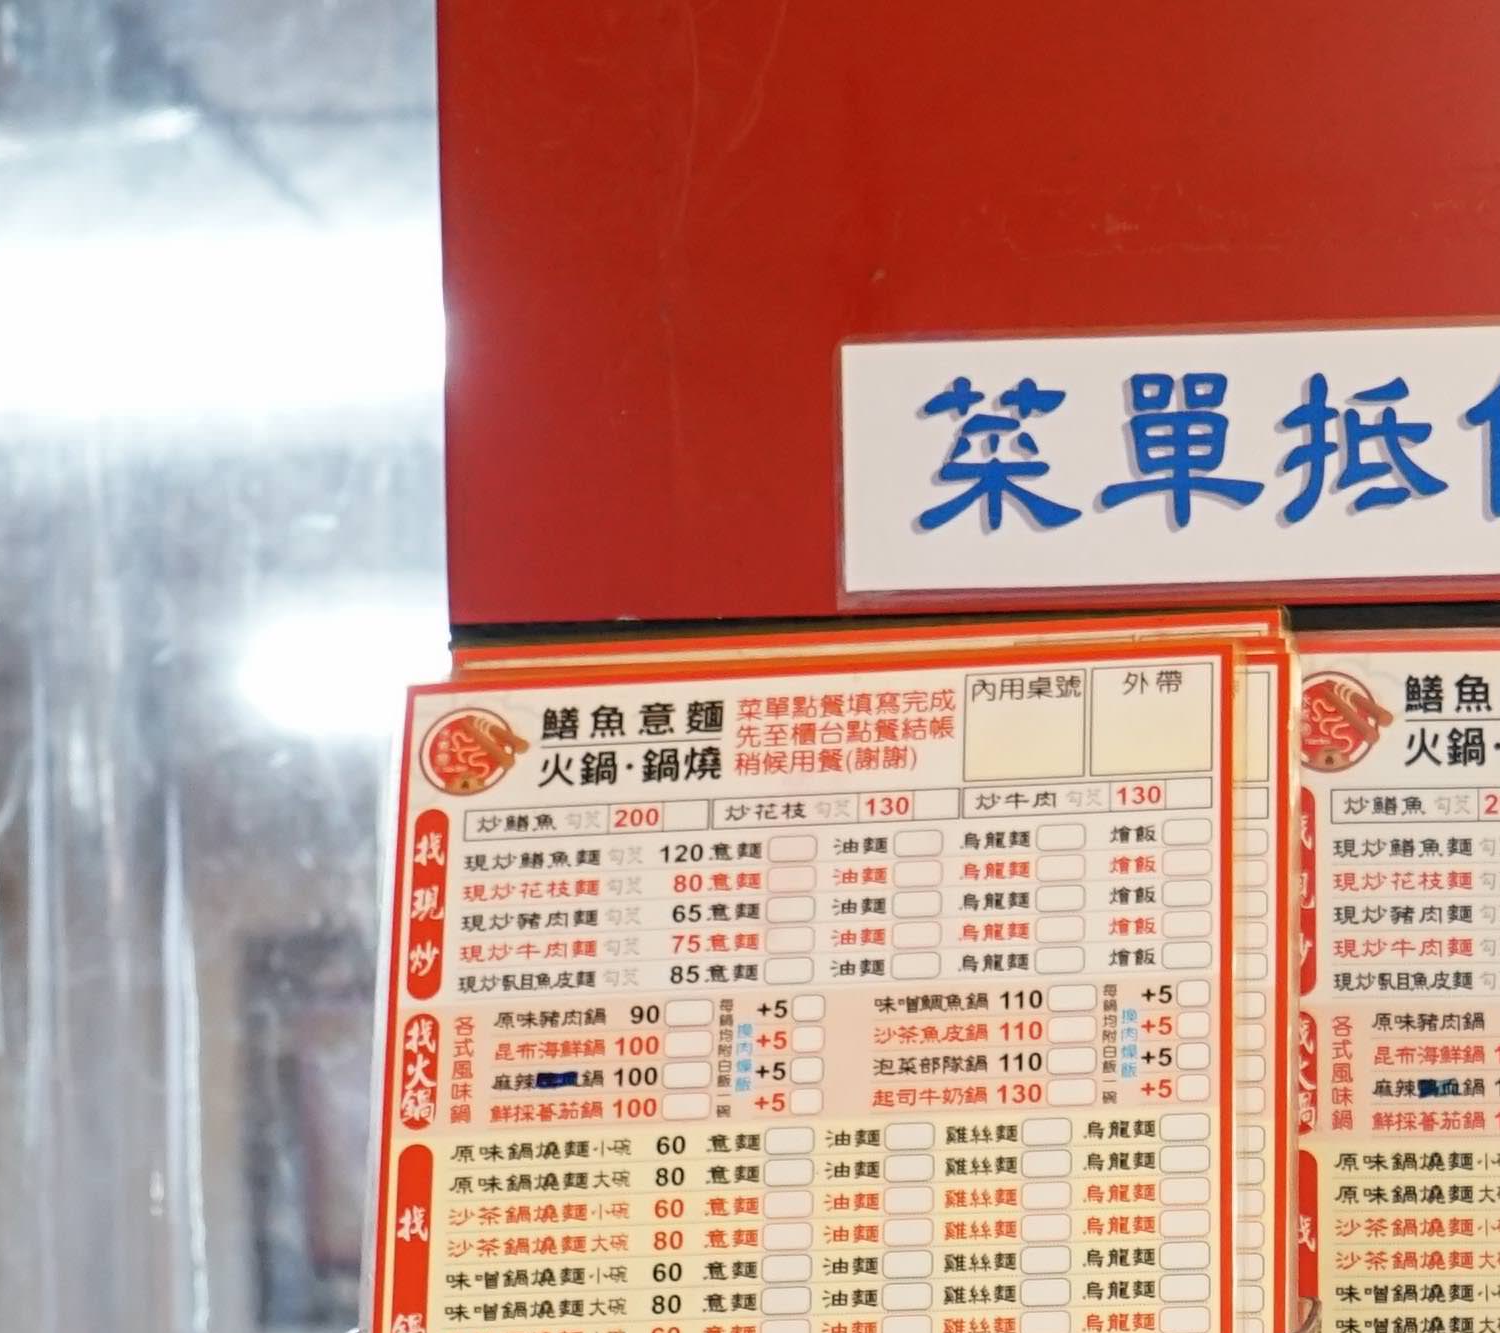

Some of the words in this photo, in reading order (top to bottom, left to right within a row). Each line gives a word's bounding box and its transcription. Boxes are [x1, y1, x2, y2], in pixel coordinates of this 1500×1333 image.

[1122, 670, 1183, 695] 外帶
[737, 689, 956, 720] 菜單點餐填寫完成
[541, 700, 724, 740] 鱔魚意麵
[737, 716, 955, 748] 先至櫃台點餐結帳
[725, 802, 807, 821] 炒花枝
[865, 797, 909, 815] 130
[976, 791, 1057, 810] 炒牛肉
[1116, 786, 1161, 805] 130
[477, 814, 556, 833] 炒鱔魚
[614, 809, 659, 827] 200
[463, 849, 600, 872] 現炒鱔魚麵
[660, 844, 702, 862] 120
[708, 841, 762, 861] 意麵
[834, 835, 888, 856] 油麵
[960, 830, 1031, 850] 烏龍麵
[462, 879, 599, 902] 現炒花枝麵
[673, 873, 702, 892] 80
[708, 871, 762, 891] 意麵
[833, 866, 887, 886] 油麵
[959, 861, 1030, 880] 烏龍麵
[461, 910, 598, 932] 現炒豬肉麵
[672, 904, 701, 922] 65
[459, 940, 597, 963] 現炒牛肉麵
[672, 935, 701, 954] 75
[671, 966, 699, 984] 85
[1000, 990, 1042, 1008] 110
[1141, 986, 1172, 1003] +5
[493, 1008, 606, 1028] 原味豬肉鍋
[630, 1005, 660, 1025] 90
[757, 1000, 787, 1017] +5
[874, 1023, 988, 1044] 沙茶魚皮鍋
[1000, 1022, 1042, 1040] 110
[494, 1038, 605, 1061] 昆布海鮮鍋
[615, 1037, 659, 1055] 100
[450, 1016, 475, 1123] 各式風味鍋
[873, 1055, 988, 1075] 泡菜部隊鍋
[999, 1053, 1042, 1072] 110
[491, 1070, 603, 1090] 麻辣鍋
[614, 1068, 658, 1086] 100
[872, 1086, 988, 1107] 起司牛奶鍋
[997, 1084, 1042, 1103] 130
[613, 1099, 657, 1118] 100
[657, 1136, 685, 1155] 60
